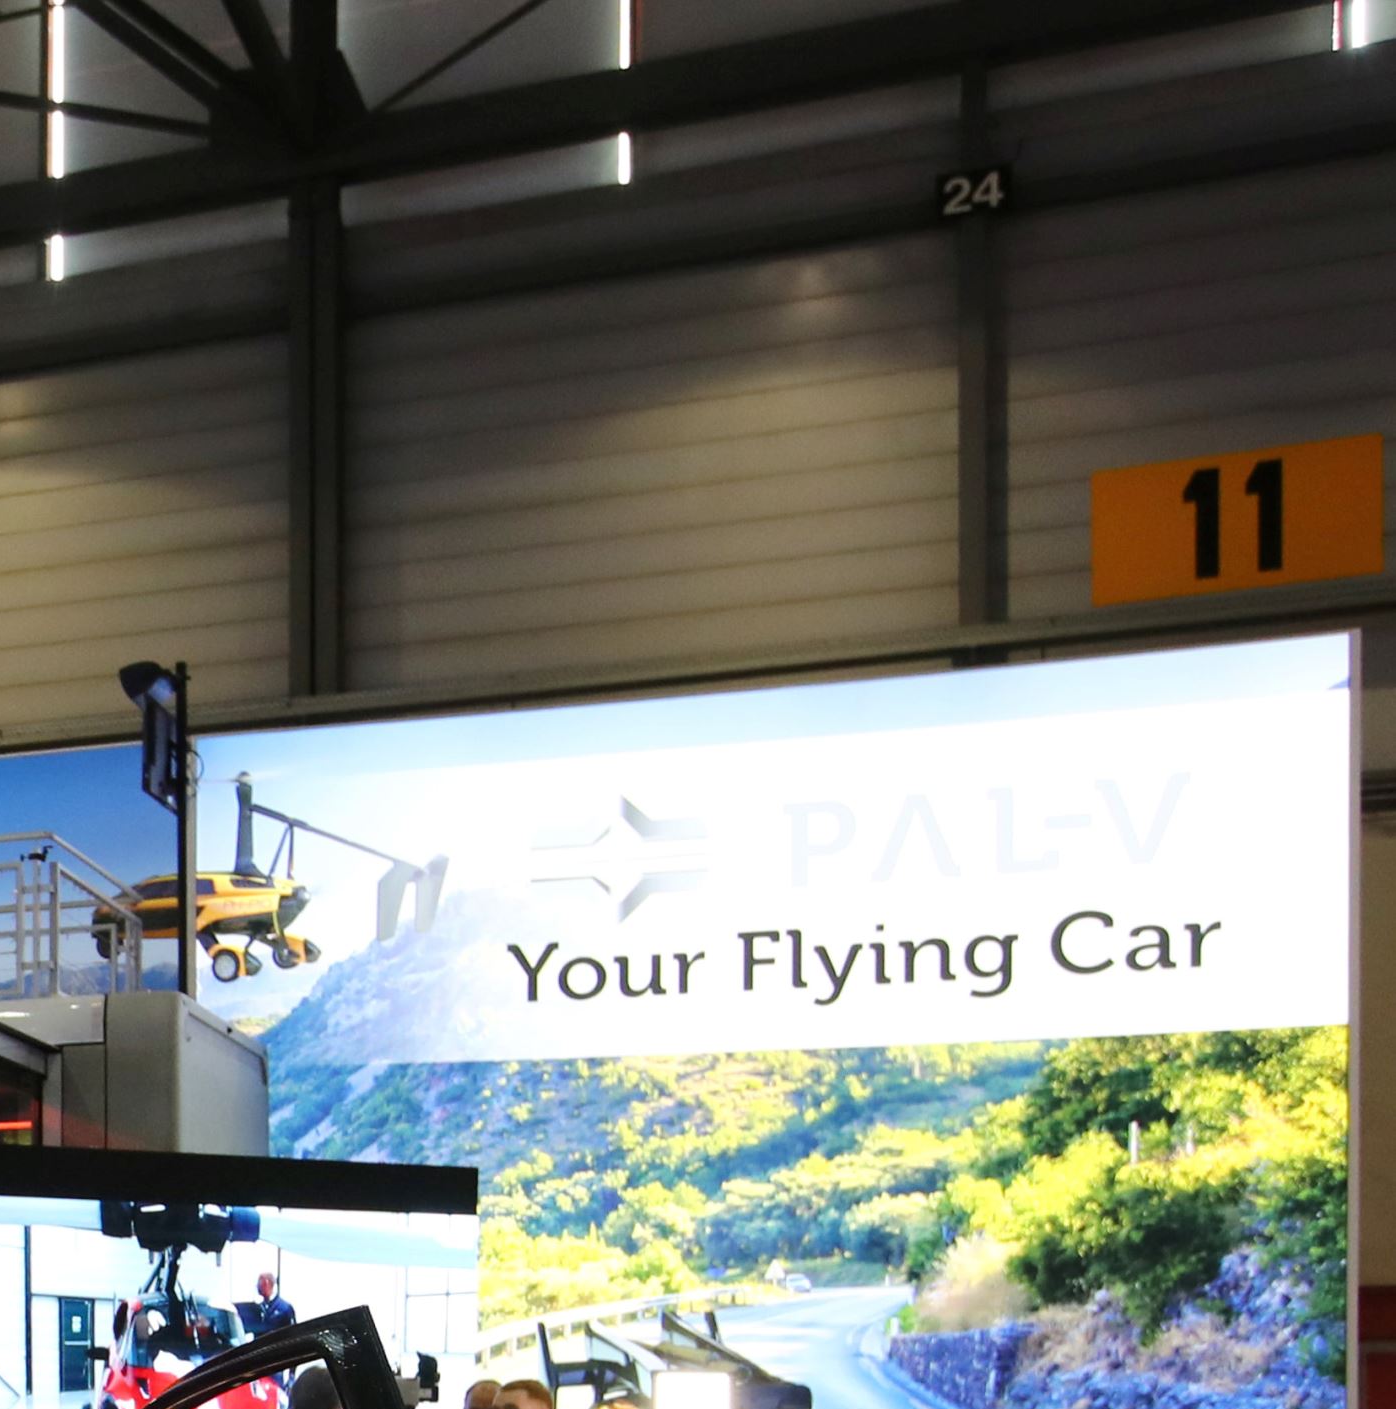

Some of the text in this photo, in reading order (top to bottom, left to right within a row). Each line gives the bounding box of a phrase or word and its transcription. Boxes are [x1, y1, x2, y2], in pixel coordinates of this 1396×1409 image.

[942, 171, 1004, 216] 24
[1181, 458, 1284, 580] 11
[783, 771, 1191, 888] PAL-V
[507, 910, 1222, 1006] Your Flying Car
